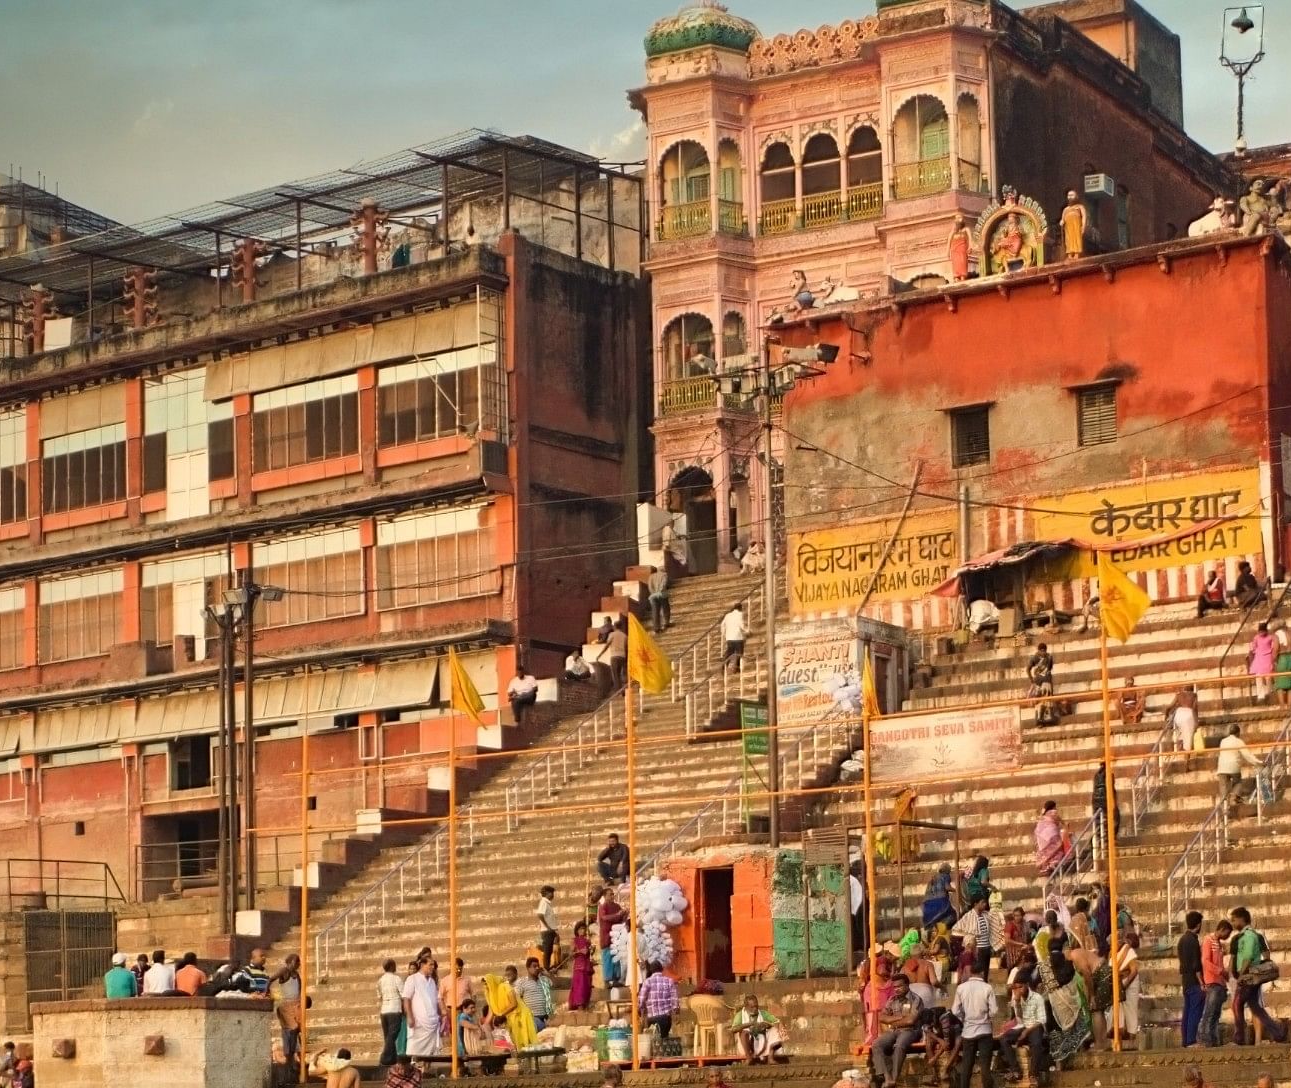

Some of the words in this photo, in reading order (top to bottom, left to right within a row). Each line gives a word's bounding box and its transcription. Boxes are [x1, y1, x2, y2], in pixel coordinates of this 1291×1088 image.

[1090, 497, 1185, 537] केदार
[1190, 489, 1241, 523] घाट
[1176, 525, 1245, 556] GHAT
[912, 564, 950, 588] GHAT
[782, 643, 850, 667] SHANTI
[777, 667, 818, 685] Guest
[870, 726, 930, 744] GANGOTRI
[934, 723, 964, 737] SEVA
[969, 717, 1015, 733] SAMITI
